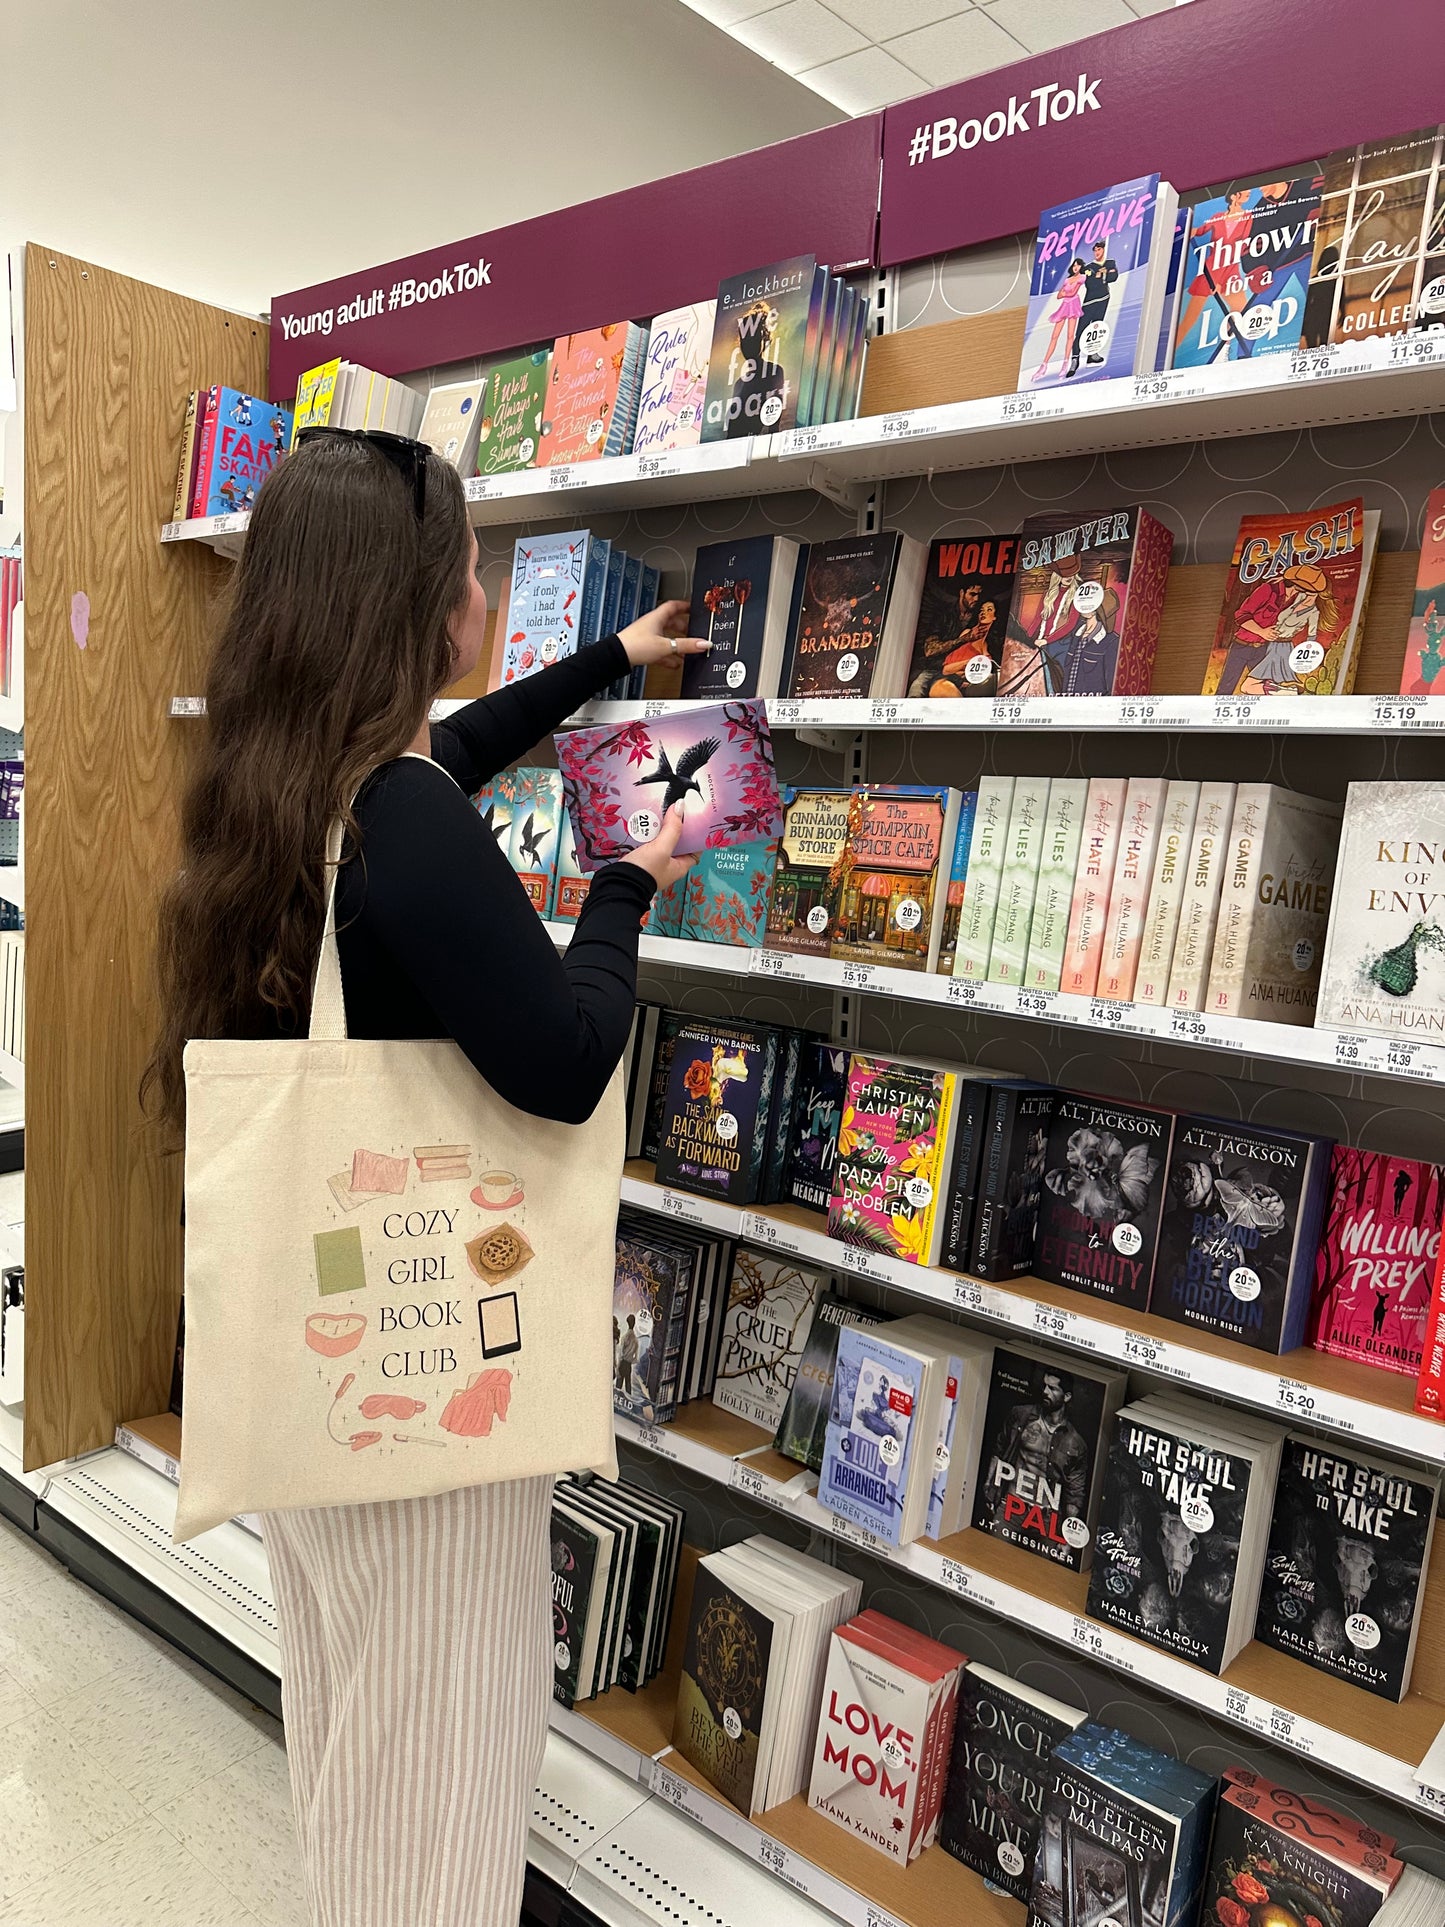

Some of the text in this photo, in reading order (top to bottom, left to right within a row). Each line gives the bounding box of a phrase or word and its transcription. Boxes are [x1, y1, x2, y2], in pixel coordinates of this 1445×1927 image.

[908, 73, 1102, 167] #BookTok
[1038, 193, 1153, 265] REVOLVE
[1193, 217, 1319, 277] Thrown
[723, 292, 736, 306] e.
[743, 270, 803, 300] lockhart
[1224, 270, 1273, 297] for a
[280, 258, 493, 341] Young adult #BookTok
[737, 308, 780, 340] we
[1342, 302, 1425, 334] COLLEEN
[648, 328, 688, 365] Rules
[1390, 343, 1434, 359] 11.96
[728, 337, 780, 385] fell
[1290, 358, 1330, 374] 12.76
[640, 381, 674, 420] Fake
[1134, 382, 1168, 396] 14.39
[706, 380, 793, 433] apart
[1002, 402, 1032, 415] 15.20
[882, 421, 909, 433] 14.39
[792, 435, 817, 448] 15.19
[550, 474, 569, 486] 16.00
[638, 462, 659, 473] 18.39
[1022, 512, 1131, 571] SAWYER
[1238, 506, 1357, 584] CASH
[800, 632, 874, 655] BRANDED
[776, 707, 800, 718] 14.39
[871, 707, 897, 719] 15.19
[992, 707, 1021, 719] 15.19
[1120, 706, 1154, 718] 15.19
[1214, 706, 1251, 718] 15.19
[1374, 707, 1416, 720] 15.19
[815, 800, 832, 812] The
[886, 804, 908, 820] The
[790, 826, 816, 840] BUN
[861, 820, 930, 840] PUMPKIN
[980, 827, 994, 857] LIES
[714, 852, 750, 864] HUNGER
[798, 840, 837, 855] STORE
[852, 838, 934, 860] SPICE CAFÉ
[1086, 837, 1103, 876] HATE
[1376, 840, 1445, 865] KIN
[716, 861, 745, 871] GAMES
[1232, 838, 1252, 890] GAMES
[1405, 871, 1431, 886] OF
[778, 935, 828, 948] LAURIE GILMORE
[760, 958, 782, 970] 15.19
[842, 971, 868, 983] 15.19
[948, 986, 976, 1000] 14.39
[950, 977, 970, 985] TWISTED
[1018, 986, 1059, 998] TWISTED HATE
[1017, 996, 1047, 1010] 14.39
[1090, 1007, 1122, 1022] 14.39
[1091, 998, 1136, 1010] TWISTED GAME
[1172, 1009, 1202, 1018] TWISTED
[1171, 1020, 1206, 1035] 14.39
[1340, 1003, 1445, 1032] ANA HUAN
[678, 1030, 761, 1054] JENNIFER LYNN BARNES
[1334, 1044, 1359, 1059] 14.39
[1386, 1052, 1412, 1066] 14.39
[851, 1081, 936, 1112] CHRISTINA
[856, 1098, 925, 1126] LAUREN
[1058, 1106, 1162, 1138] A.L. JACKSON
[672, 1114, 739, 1150] BACKWARD
[666, 1136, 741, 1172] AS FORWARD
[868, 1144, 898, 1167] The
[1182, 1131, 1298, 1168] A.L. JACKSON
[662, 1197, 683, 1210] 16.79
[792, 1183, 824, 1206] MEAGAN
[844, 1188, 913, 1221] PROBLEM
[383, 1208, 460, 1239] COZY
[754, 1224, 777, 1238] 15.19
[1340, 1208, 1442, 1259] WILLING
[842, 1252, 867, 1268] 15.19
[1208, 1237, 1237, 1261] the
[387, 1256, 455, 1285] GIRL
[1042, 1234, 1144, 1292] ETERNITY
[1061, 1270, 1115, 1294] MOONLIT RIDGE
[1348, 1257, 1426, 1302] PREY
[954, 1288, 982, 1305] 14.39
[1172, 1276, 1265, 1330] HORIZON
[379, 1300, 463, 1333] BOOK
[1034, 1312, 1065, 1331] 14.39
[1036, 1302, 1078, 1320] FROM HERE TO
[1184, 1308, 1244, 1334] MOONLIT RIDGE
[736, 1310, 793, 1352] CRUEL
[1126, 1331, 1164, 1346] BEYOND THE
[1124, 1341, 1157, 1360] 14.39
[1332, 1329, 1362, 1348] ALLIE
[1366, 1338, 1422, 1366] OLEANDER
[381, 1348, 458, 1378] CLUB
[726, 1340, 800, 1392] PRINCE
[720, 1391, 781, 1430] HOLLY BLAC
[1278, 1389, 1314, 1411] 15.20
[850, 1436, 884, 1475] LOVE
[1128, 1428, 1237, 1492] HER SOUL
[834, 1463, 887, 1506] ARRANGED
[994, 1459, 1062, 1512] PEN
[1140, 1466, 1214, 1507] TO TAKE
[1302, 1451, 1418, 1517] HER SOUL
[824, 1494, 894, 1538] LAUREN ASHER
[1004, 1494, 1068, 1545] PAL
[1316, 1490, 1394, 1542] TO TAKE
[978, 1518, 1075, 1566] J.T. GEISSINGER
[942, 1567, 968, 1587] 14.39
[1072, 1626, 1102, 1650] 15.16
[1101, 1600, 1210, 1656] HARLEY LAROUX
[1272, 1624, 1389, 1683] HARLEY LAROUX
[1225, 1697, 1246, 1716] 15.20
[828, 1690, 918, 1773] LOVE,
[975, 1700, 1052, 1763] ONCE
[1270, 1716, 1292, 1736] 15.20
[822, 1732, 908, 1810] MOM
[816, 1794, 900, 1856] ILIANA XANDER
[967, 1798, 1031, 1858] MINE
[1052, 1776, 1168, 1857] JODI ELLEN
[1068, 1804, 1146, 1864] MALPAS
[759, 1846, 785, 1870] 14.39
[1242, 1826, 1352, 1902] K.A. KNIGHT
